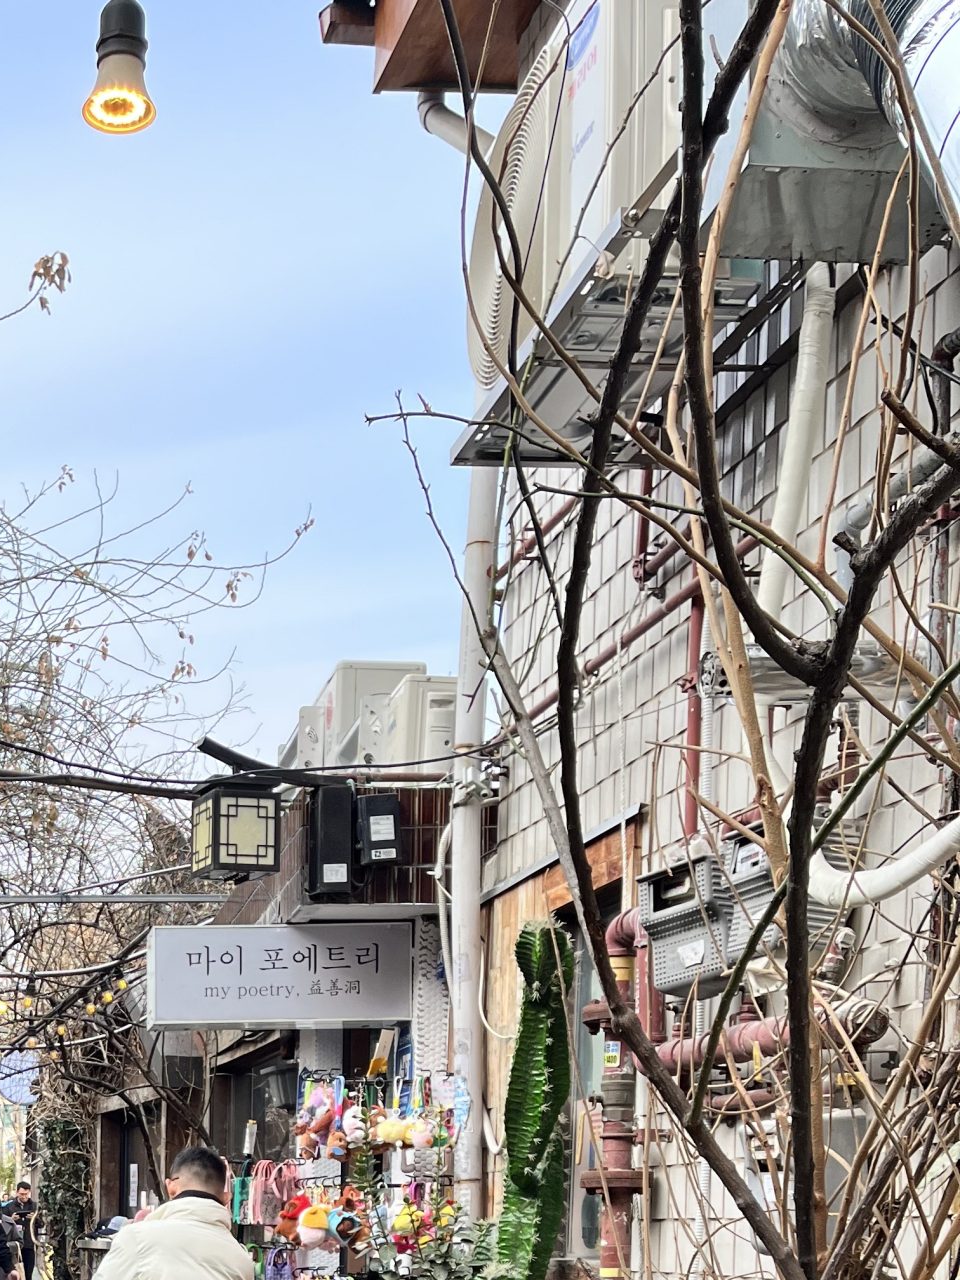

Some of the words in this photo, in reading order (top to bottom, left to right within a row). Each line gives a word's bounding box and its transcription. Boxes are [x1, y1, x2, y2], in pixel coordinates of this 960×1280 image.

[186, 944, 243, 976] 마이
[259, 943, 381, 975] 포에트리
[204, 984, 231, 999] my
[238, 983, 300, 999] poetry,
[307, 979, 361, 998] 益善洞
